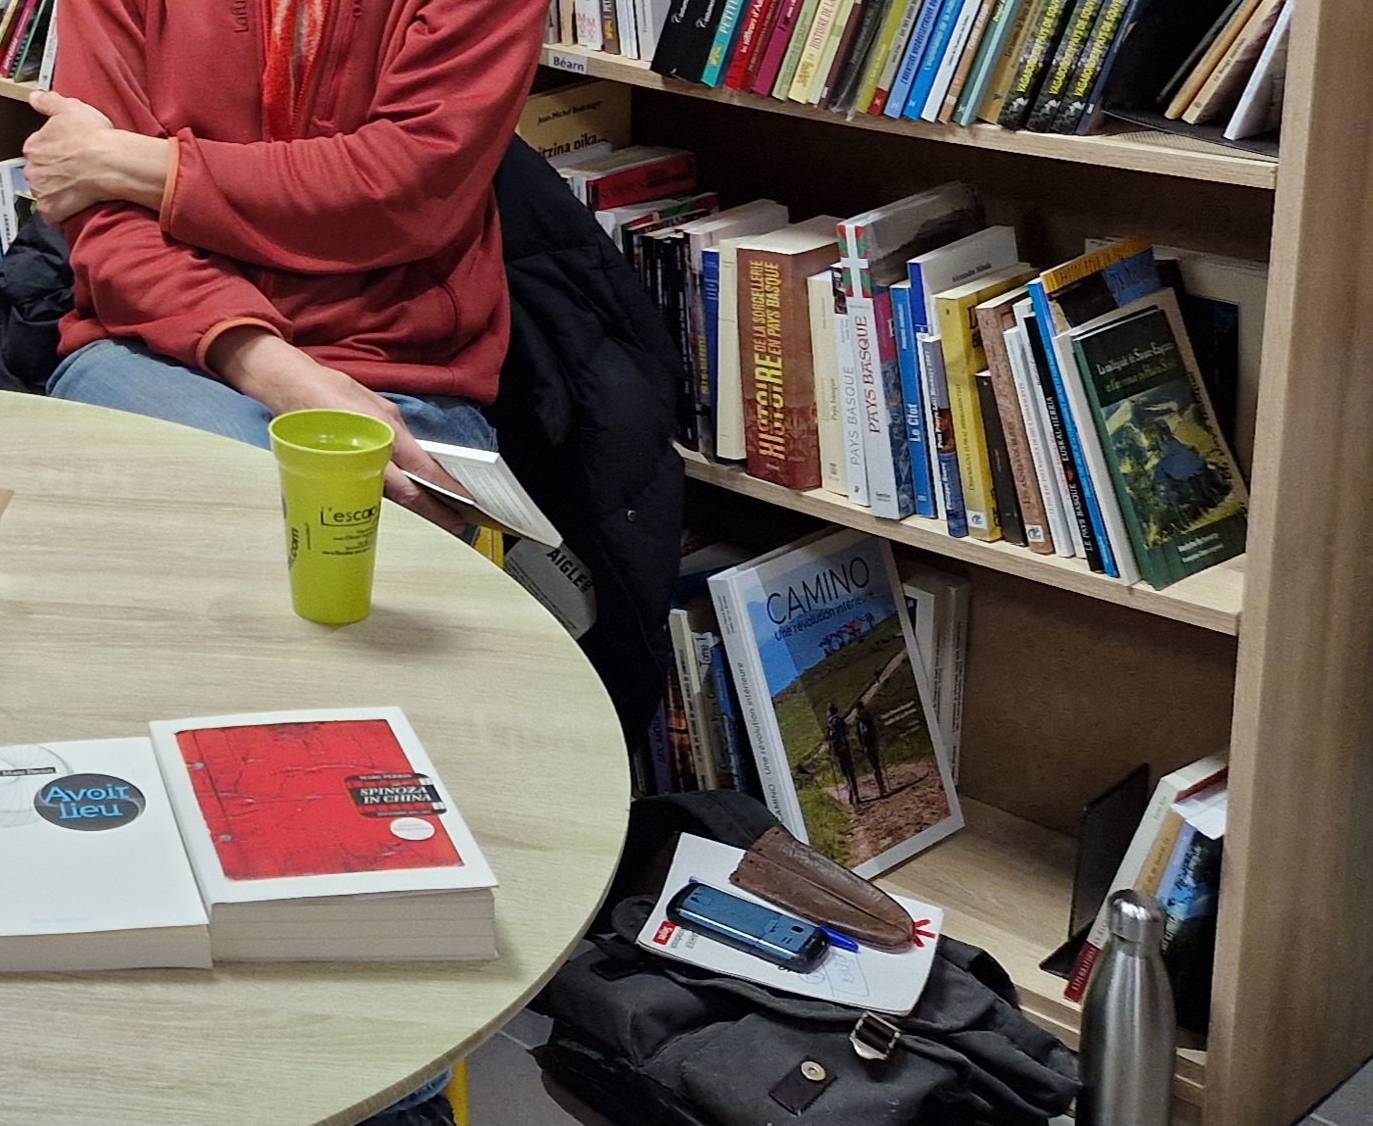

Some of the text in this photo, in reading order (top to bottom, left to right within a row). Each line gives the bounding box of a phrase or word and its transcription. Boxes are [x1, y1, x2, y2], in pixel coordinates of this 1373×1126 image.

[720, 0, 739, 34] PETITE
[1073, 20, 1087, 30] DE
[1099, 22, 1114, 32] DE
[809, 18, 830, 50] HISTOIRE
[1066, 30, 1084, 47] PAYS
[1092, 32, 1110, 48] PAYS
[553, 55, 585, 74] Béarn
[1016, 53, 1039, 92] VAGABOND
[1034, 29, 1050, 45] PAYS
[1047, 55, 1072, 94] VAGABOND
[1073, 57, 1099, 97] VAGABOND
[765, 261, 782, 355] EN PAYS BASQUE
[750, 259, 787, 460] HISTOIRE DE LA SORCELLERIE
[855, 315, 882, 434] PAYS BASQUE
[843, 365, 861, 466] PAYS BASQUE
[1044, 396, 1070, 462] EUSKAL-HERRIA
[909, 429, 920, 442] Le
[1067, 483, 1093, 551] LE PAYS BASQUE
[545, 547, 587, 591] AIGLE
[766, 556, 871, 626] CAMINO
[774, 626, 792, 641] Une
[699, 645, 712, 668] Tome
[737, 661, 773, 775] Une révolution intérieure
[44, 782, 130, 804] Avoir
[359, 785, 429, 797] SPINOZA
[364, 792, 432, 804] IN CHINA
[58, 802, 124, 822] lieu
